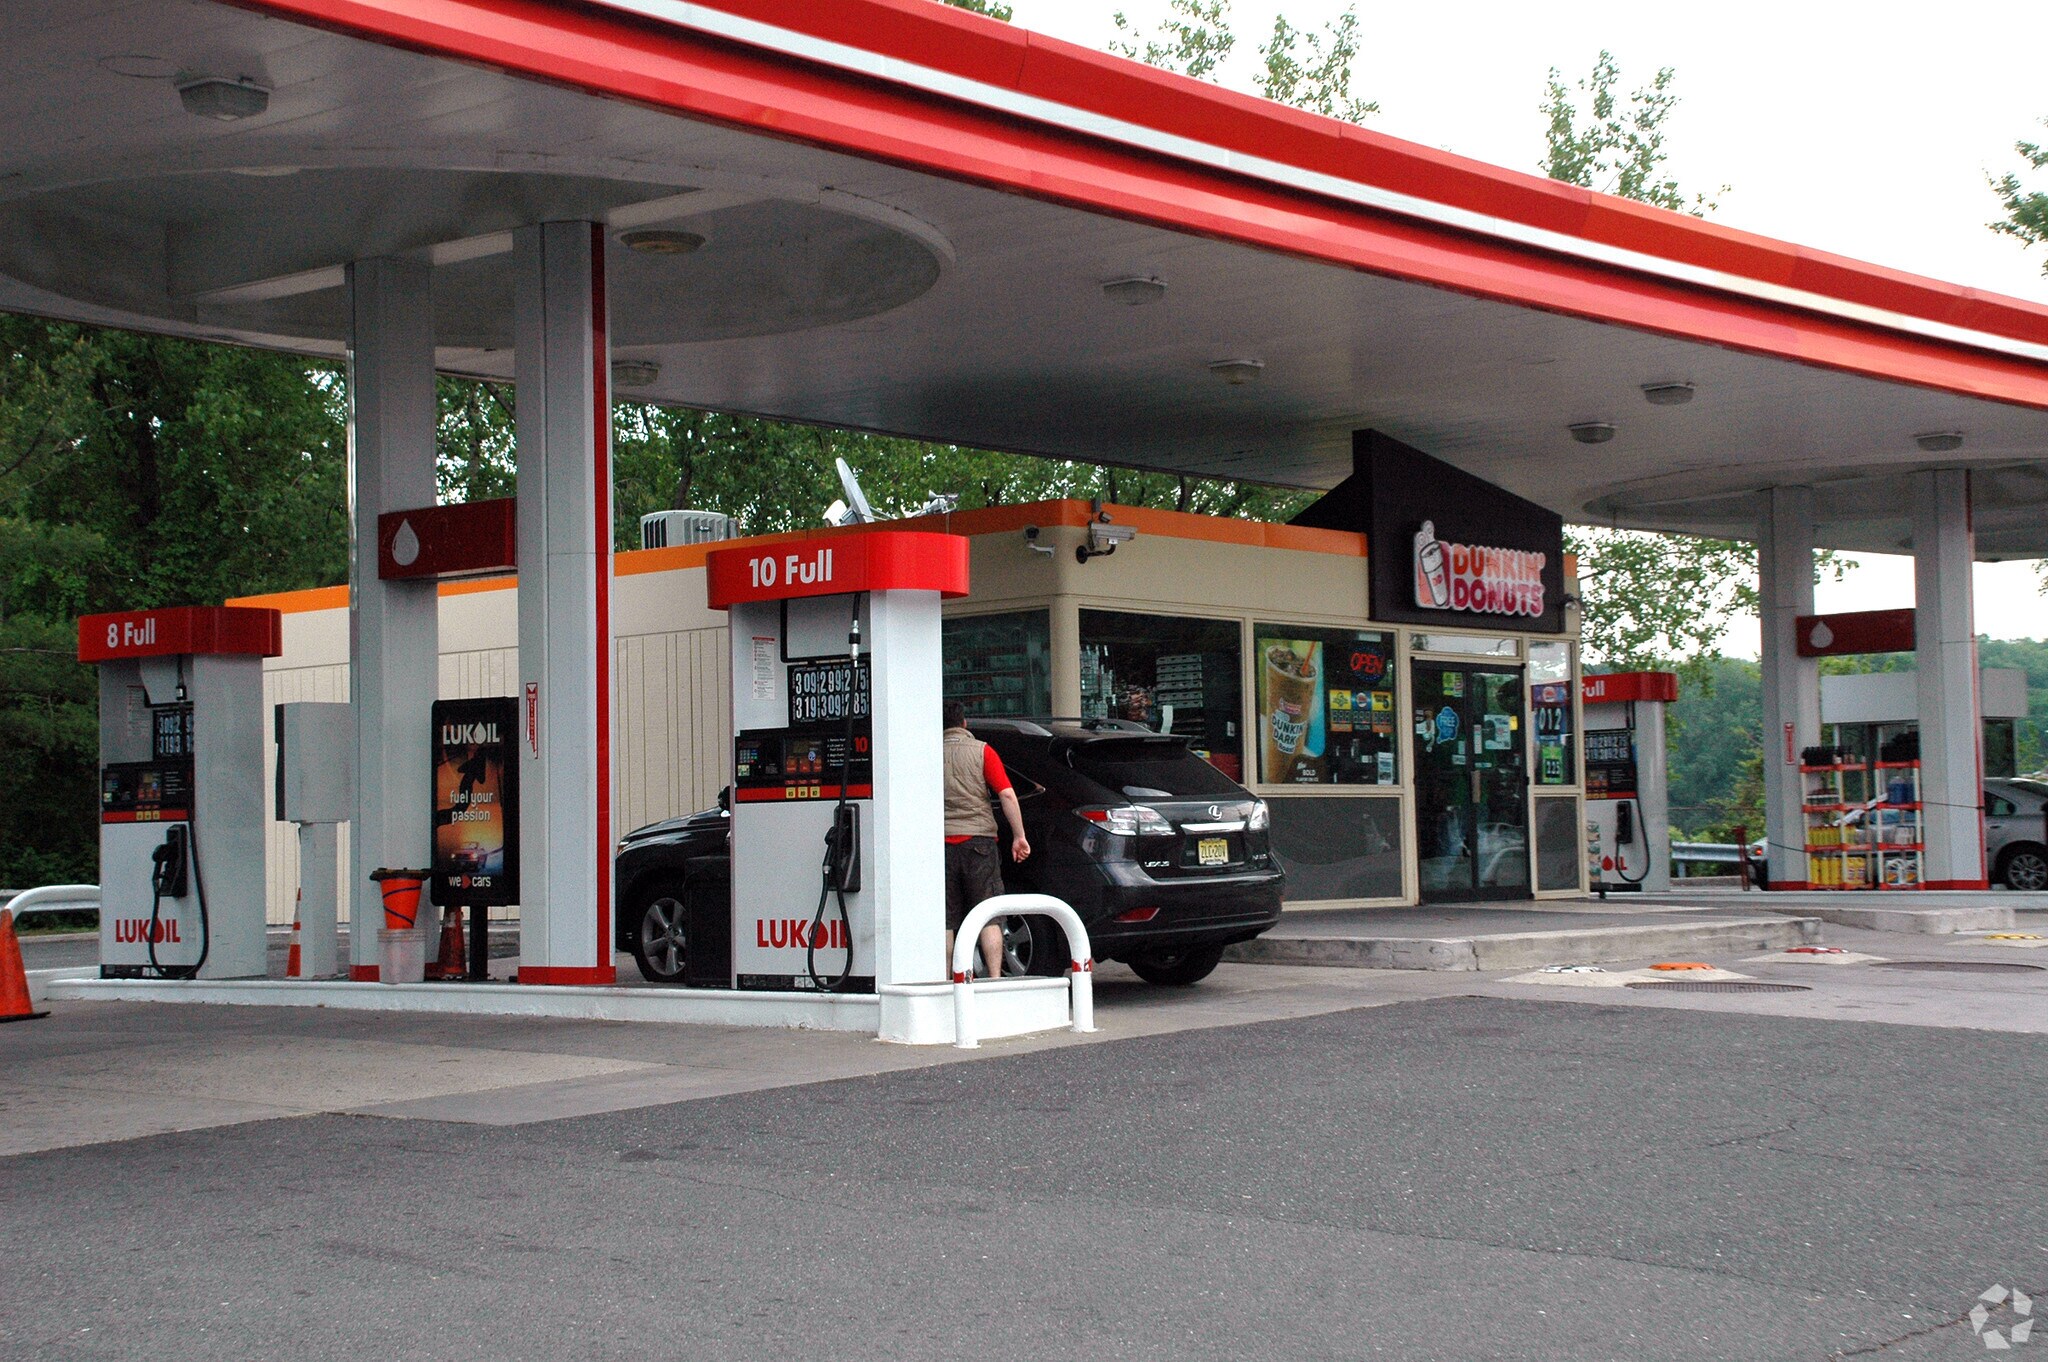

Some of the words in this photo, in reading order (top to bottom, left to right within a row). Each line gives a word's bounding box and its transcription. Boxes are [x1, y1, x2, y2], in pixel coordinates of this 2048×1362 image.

[749, 556, 776, 587] 10
[786, 549, 832, 584] Full
[1453, 544, 1545, 581] DUNKIN'
[1453, 578, 1543, 615] DONUTS
[107, 623, 119, 648] 8
[124, 618, 156, 647] Full
[1350, 652, 1385, 673] OPEN
[443, 721, 500, 745] LUKOIL
[855, 736, 869, 752] 10
[1273, 729, 1296, 746] DARK
[450, 790, 469, 804] fuel
[471, 792, 493, 808] your
[452, 807, 491, 825] passion
[448, 876, 462, 887] we
[472, 876, 491, 888] cars
[115, 917, 181, 943] LUKOIL
[756, 919, 850, 949] LUKOIL
